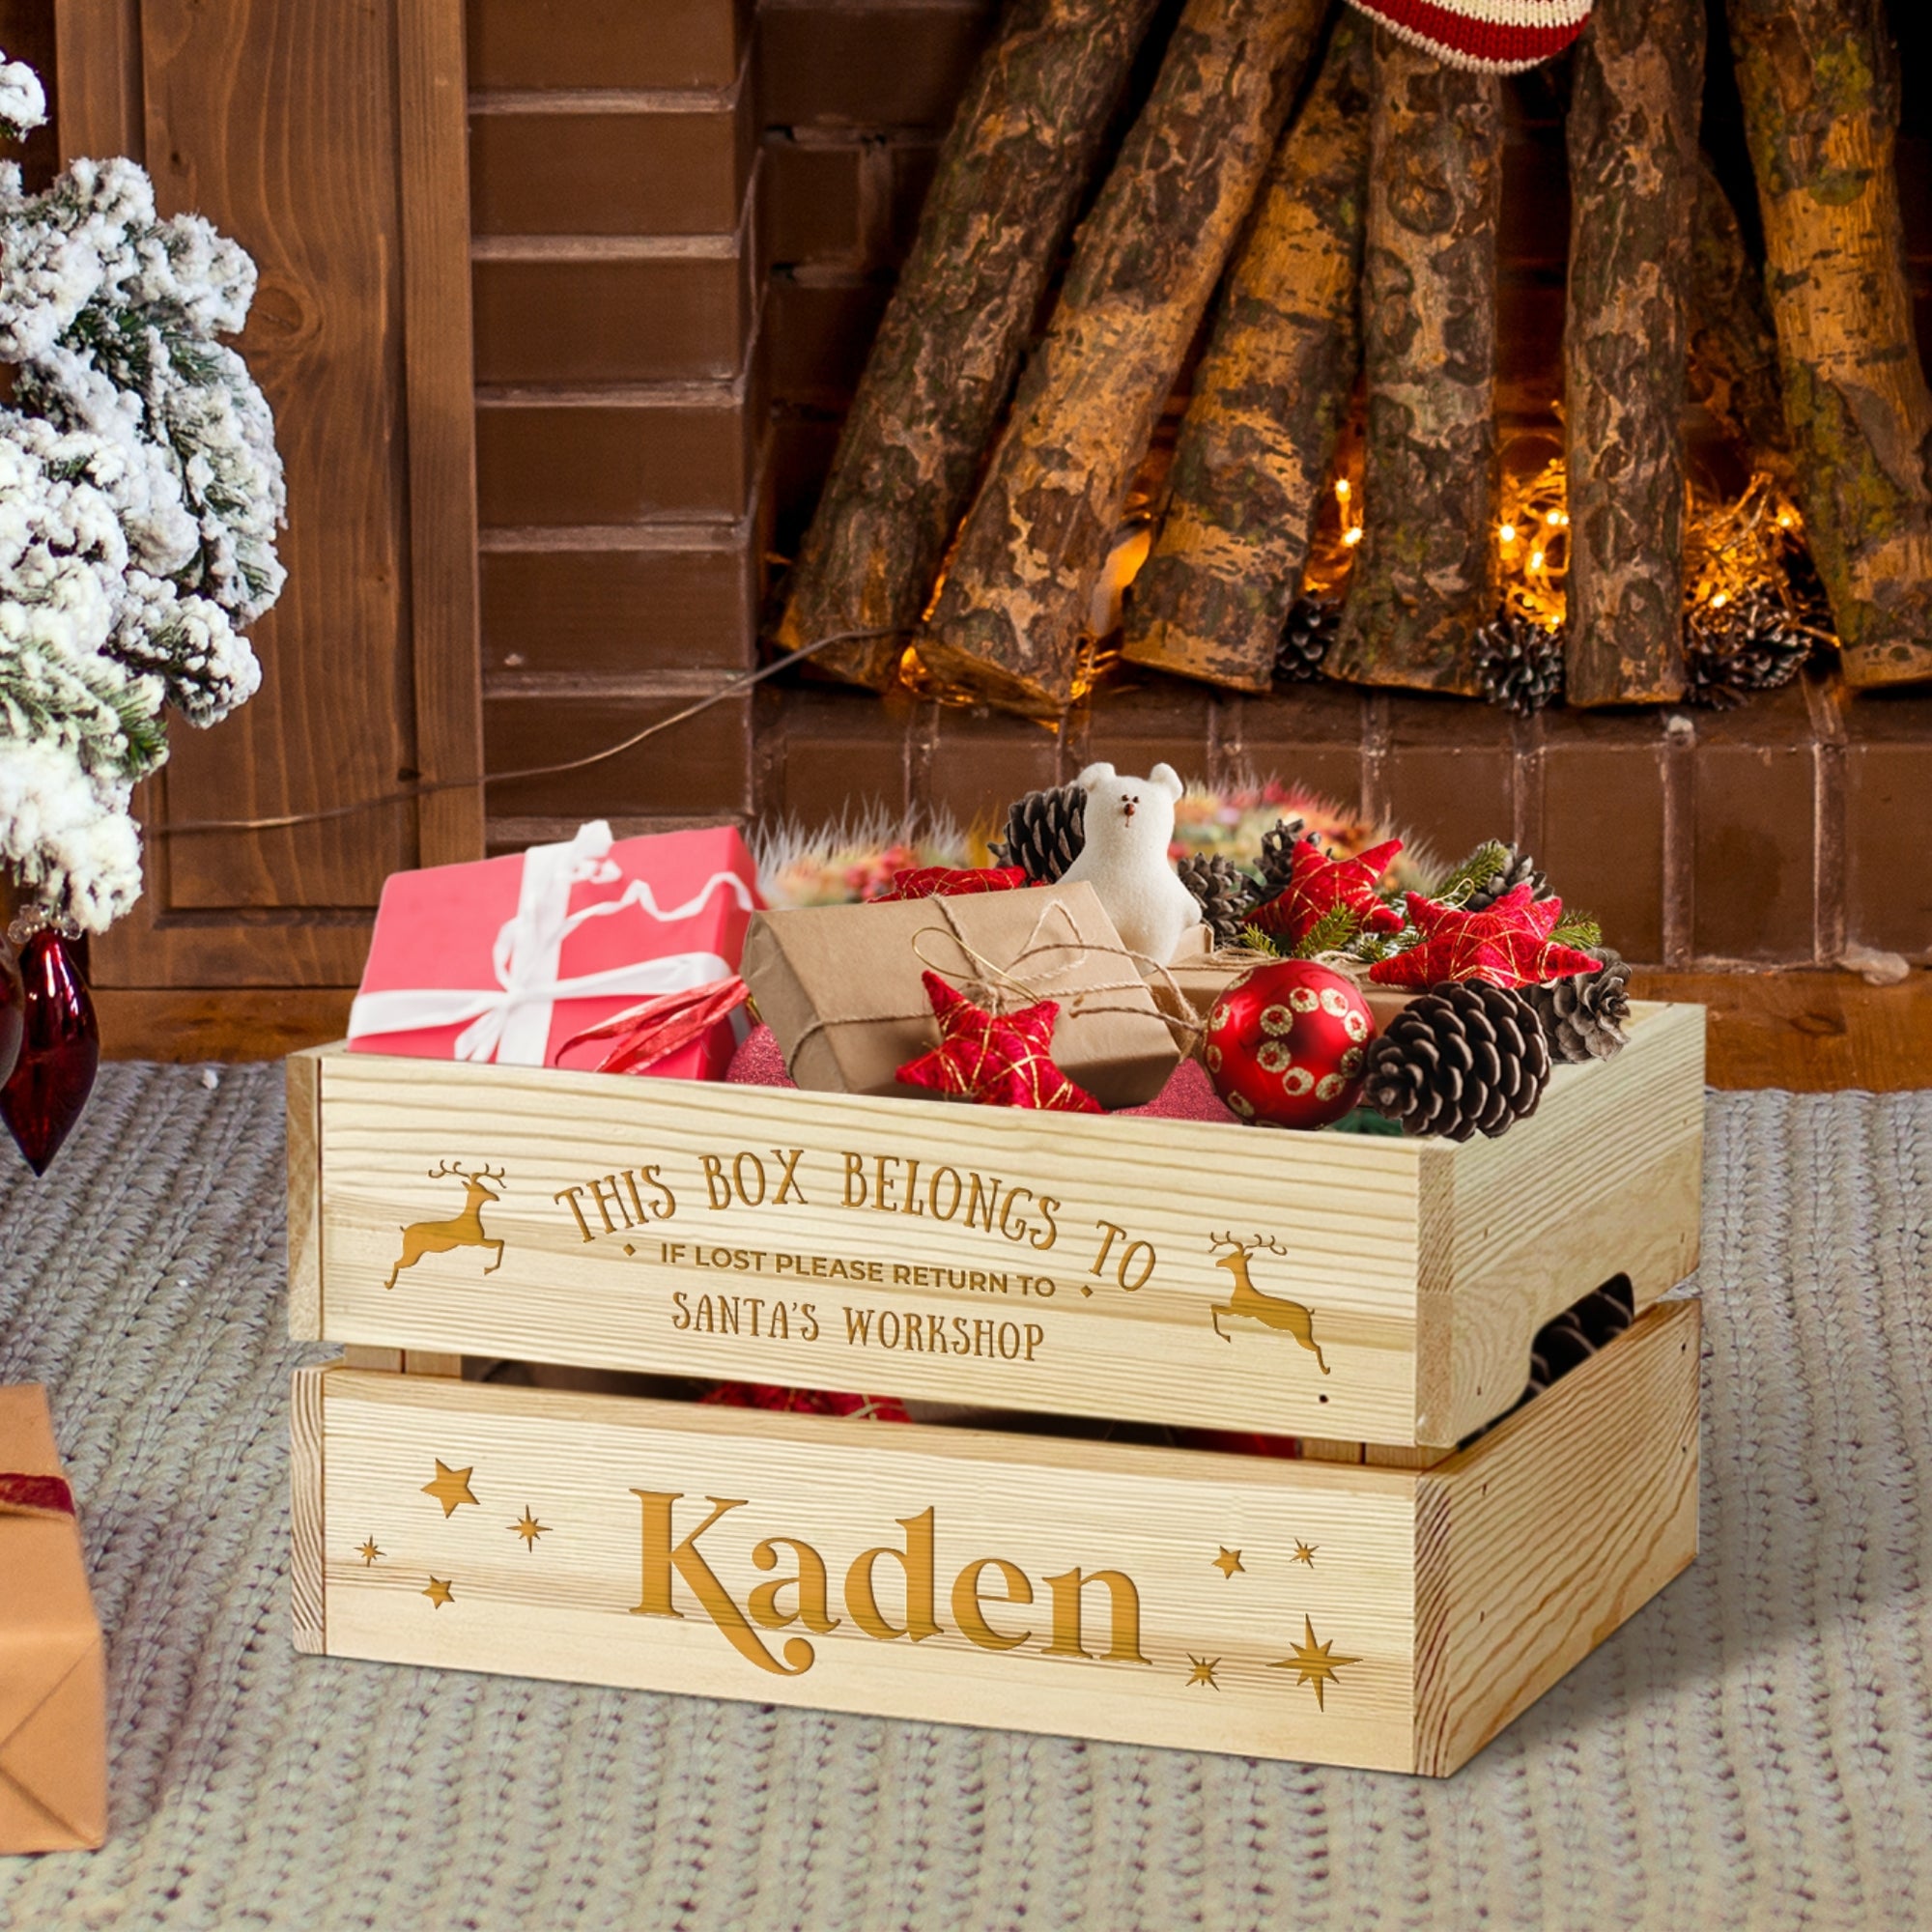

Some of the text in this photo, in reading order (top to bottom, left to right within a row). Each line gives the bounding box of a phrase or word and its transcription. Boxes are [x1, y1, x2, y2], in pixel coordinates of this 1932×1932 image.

[554, 1149, 1156, 1293] THIS BOX BELONGS TO
[661, 1242, 1056, 1298] IF LOST PLEASE RETURN TO
[672, 1291, 1045, 1362] SANTA'S WORKSHOP
[629, 1488, 1152, 1676] Kaden
